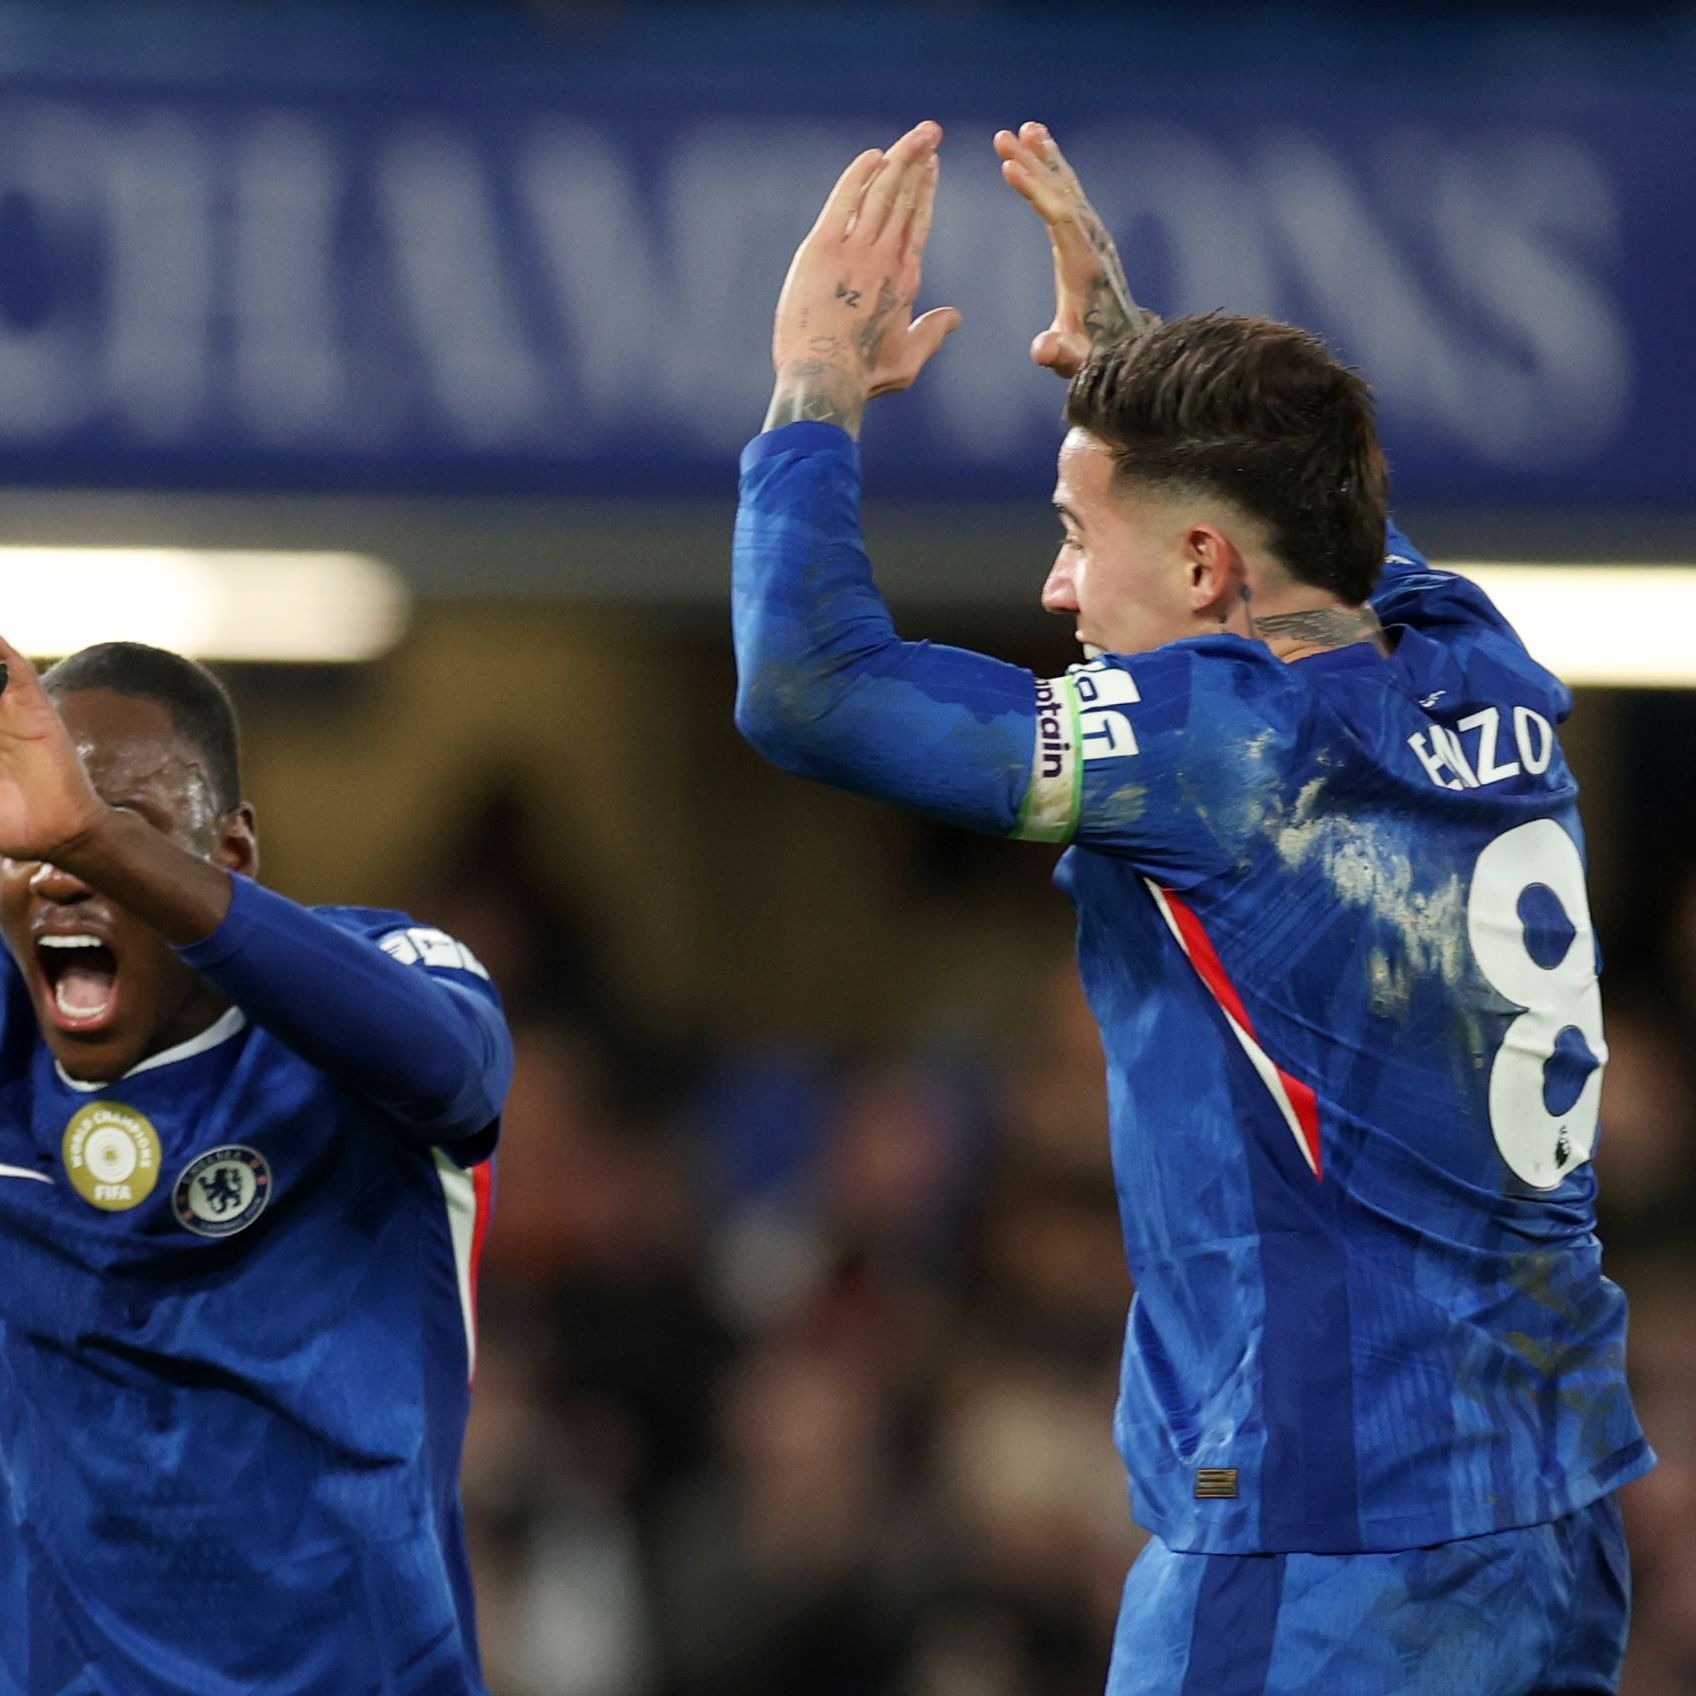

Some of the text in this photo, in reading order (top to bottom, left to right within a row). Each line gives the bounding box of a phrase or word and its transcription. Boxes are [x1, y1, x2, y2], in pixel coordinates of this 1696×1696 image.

[1407, 706, 1553, 791] ENZO
[1467, 818, 1608, 1189] 8
[94, 1185, 133, 1200] FIFA
